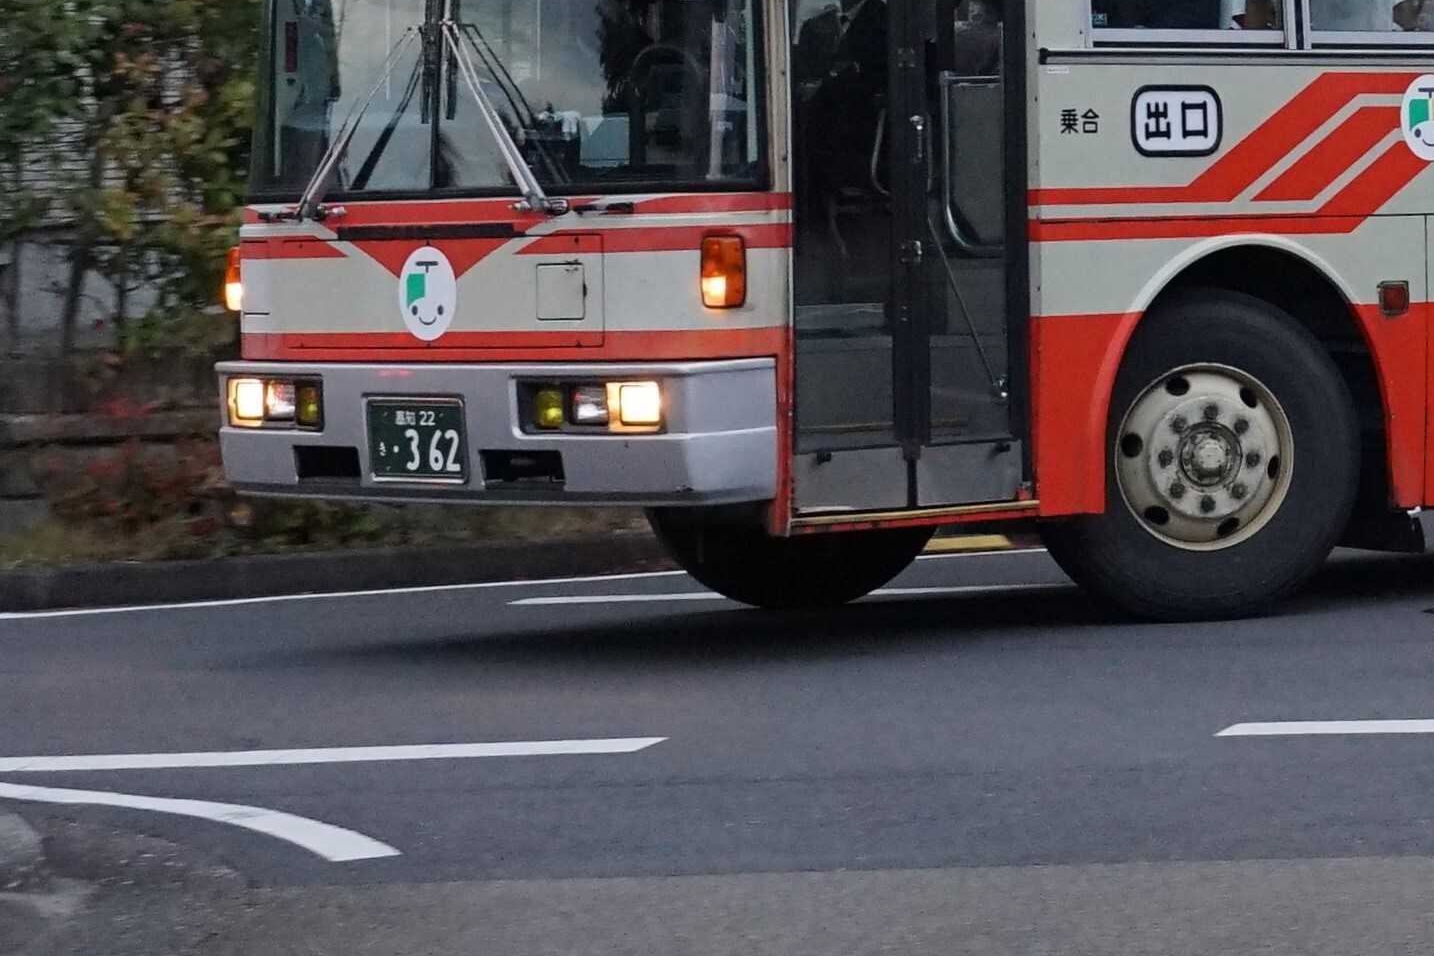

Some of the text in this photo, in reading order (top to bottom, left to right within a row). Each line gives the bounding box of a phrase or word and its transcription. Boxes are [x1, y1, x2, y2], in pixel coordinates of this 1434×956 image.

[1060, 108, 1100, 134] 乗合
[1144, 100, 1209, 141] 出口
[419, 411, 436, 425] 22
